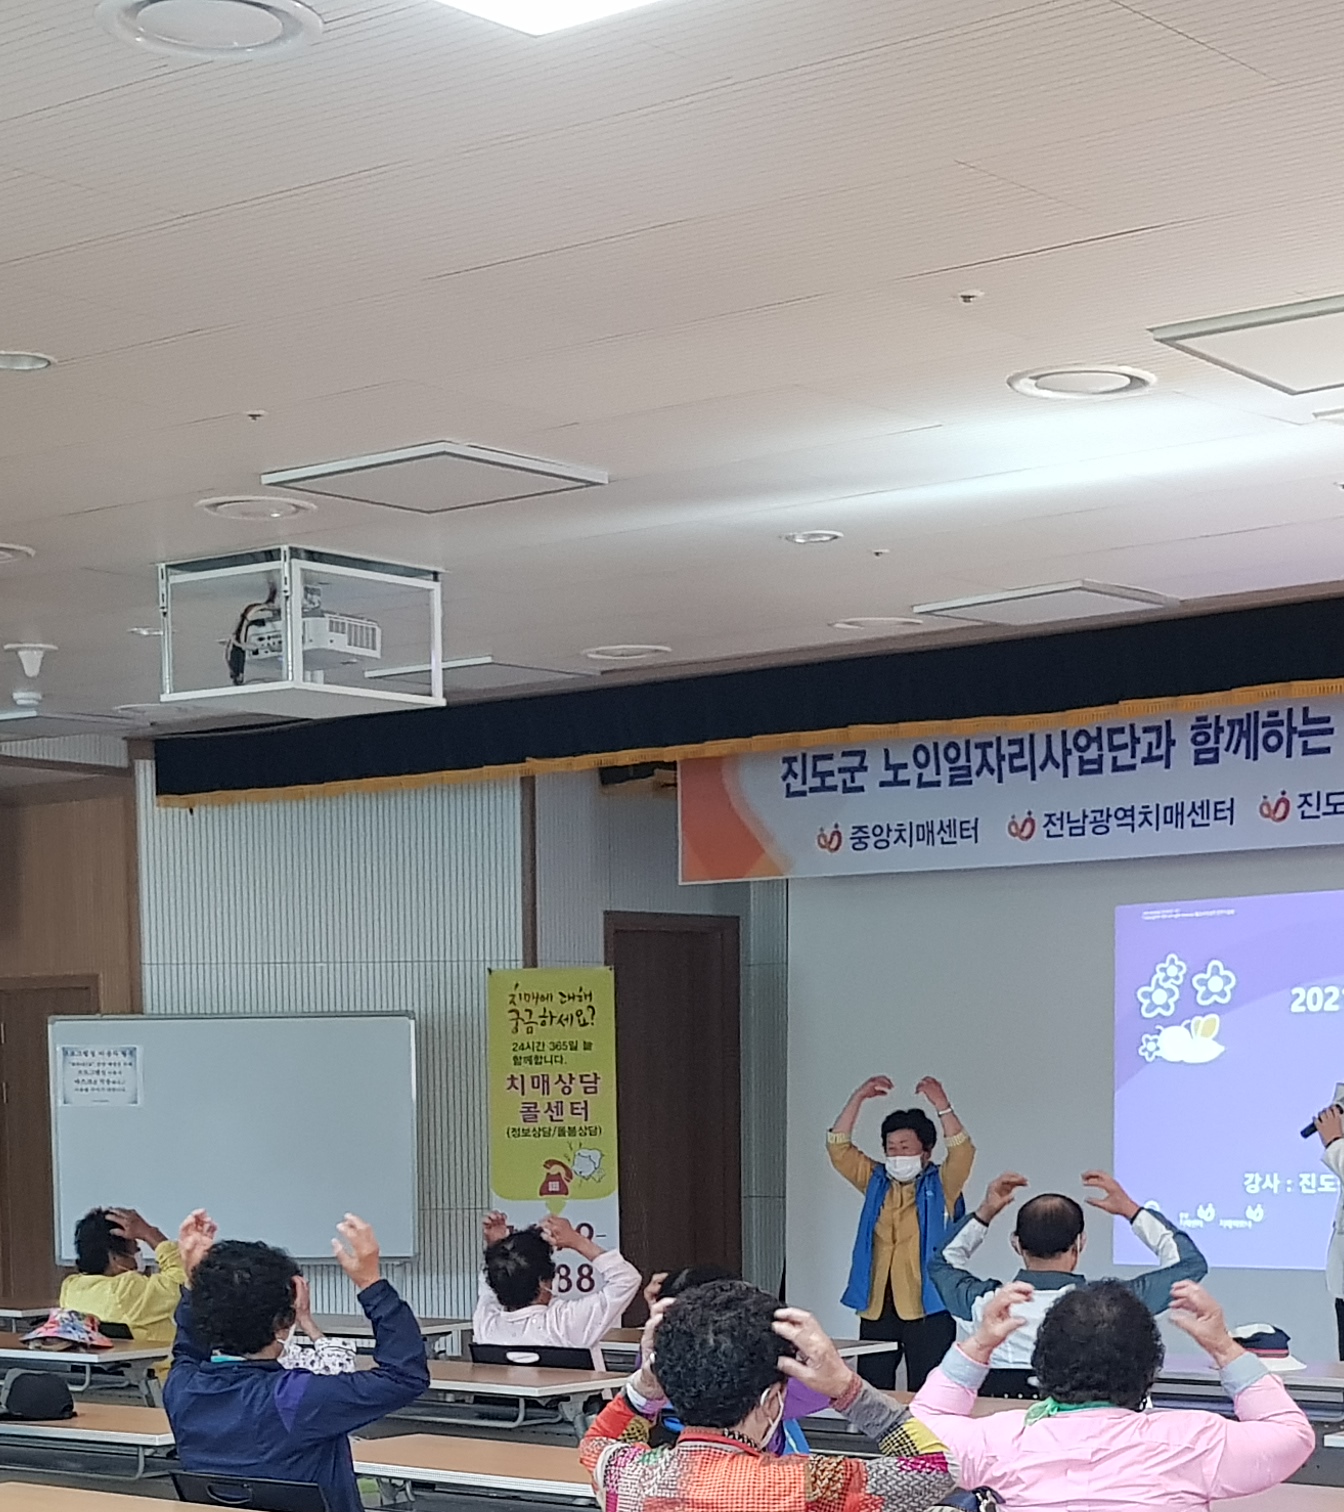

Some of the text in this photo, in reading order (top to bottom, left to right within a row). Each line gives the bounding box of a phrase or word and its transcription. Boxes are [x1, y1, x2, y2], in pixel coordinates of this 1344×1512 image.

[780, 748, 869, 798] 진도군
[878, 718, 1177, 788] 노인일자리사업단과
[1189, 706, 1335, 766] 함께하는
[1042, 798, 1236, 840] 전남광역치매센터
[848, 817, 981, 852] 중앙치매센터
[508, 982, 593, 1006] 치매에 대해
[507, 1005, 596, 1034] 궁금하세요?
[512, 1040, 545, 1052] 24시간
[548, 1040, 578, 1051] 365일
[506, 1072, 601, 1096] 치매상담
[519, 1100, 588, 1123] 콜센터
[1243, 1172, 1281, 1194] 강사
